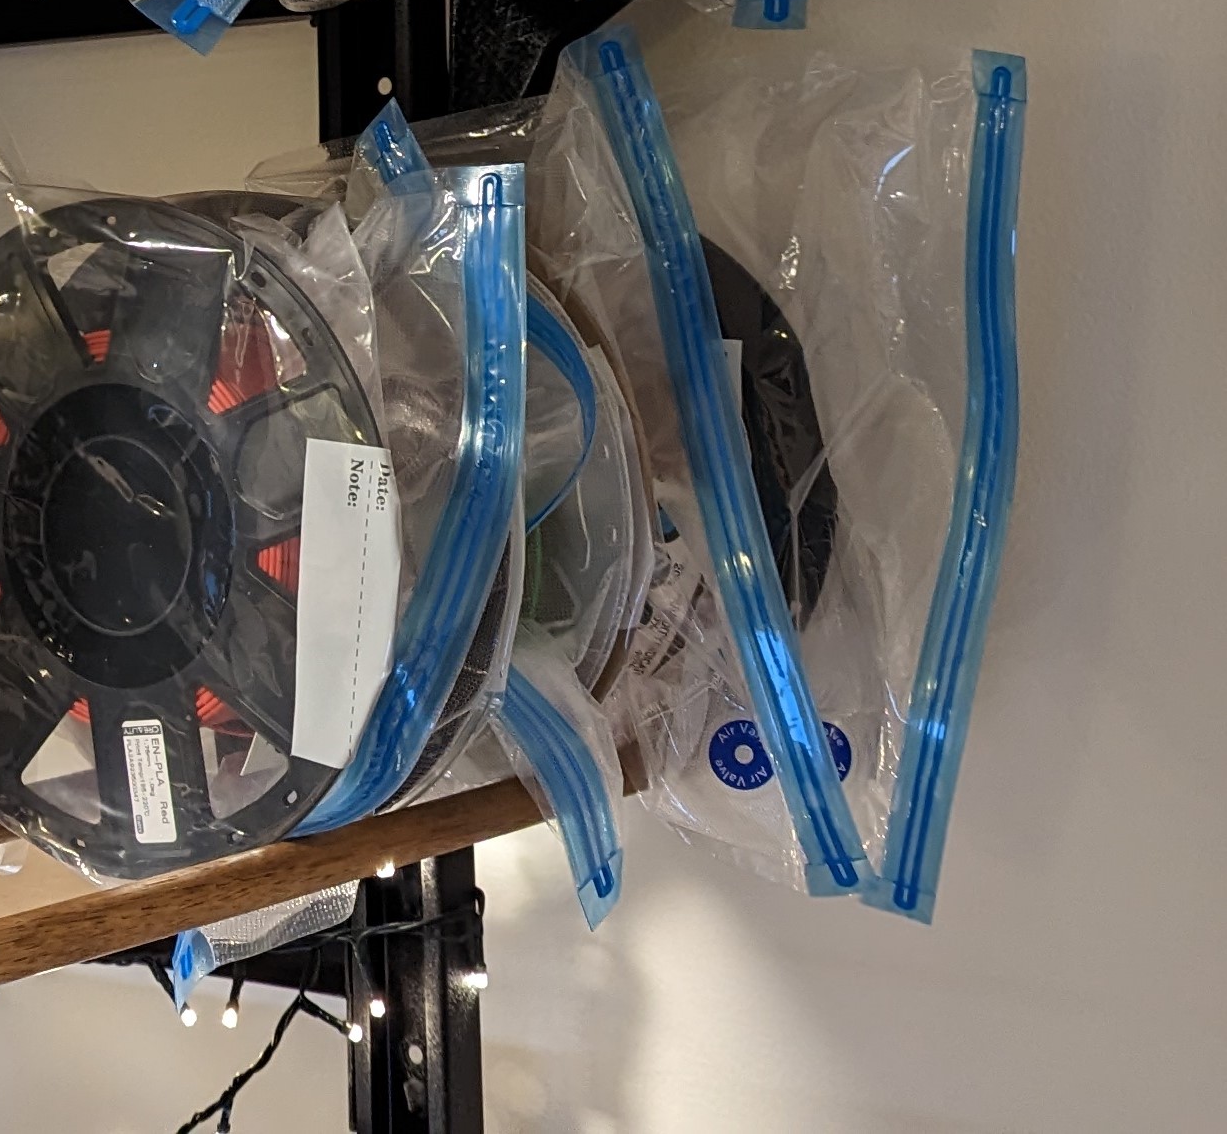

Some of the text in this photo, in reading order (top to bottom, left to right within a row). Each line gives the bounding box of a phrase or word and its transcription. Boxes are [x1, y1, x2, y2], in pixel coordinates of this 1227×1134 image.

[347, 458, 365, 507] Note:
[375, 461, 391, 511] Date:
[717, 727, 735, 744] Air
[151, 738, 170, 824] EN-PLA Red
[715, 759, 768, 787] Air Valve
